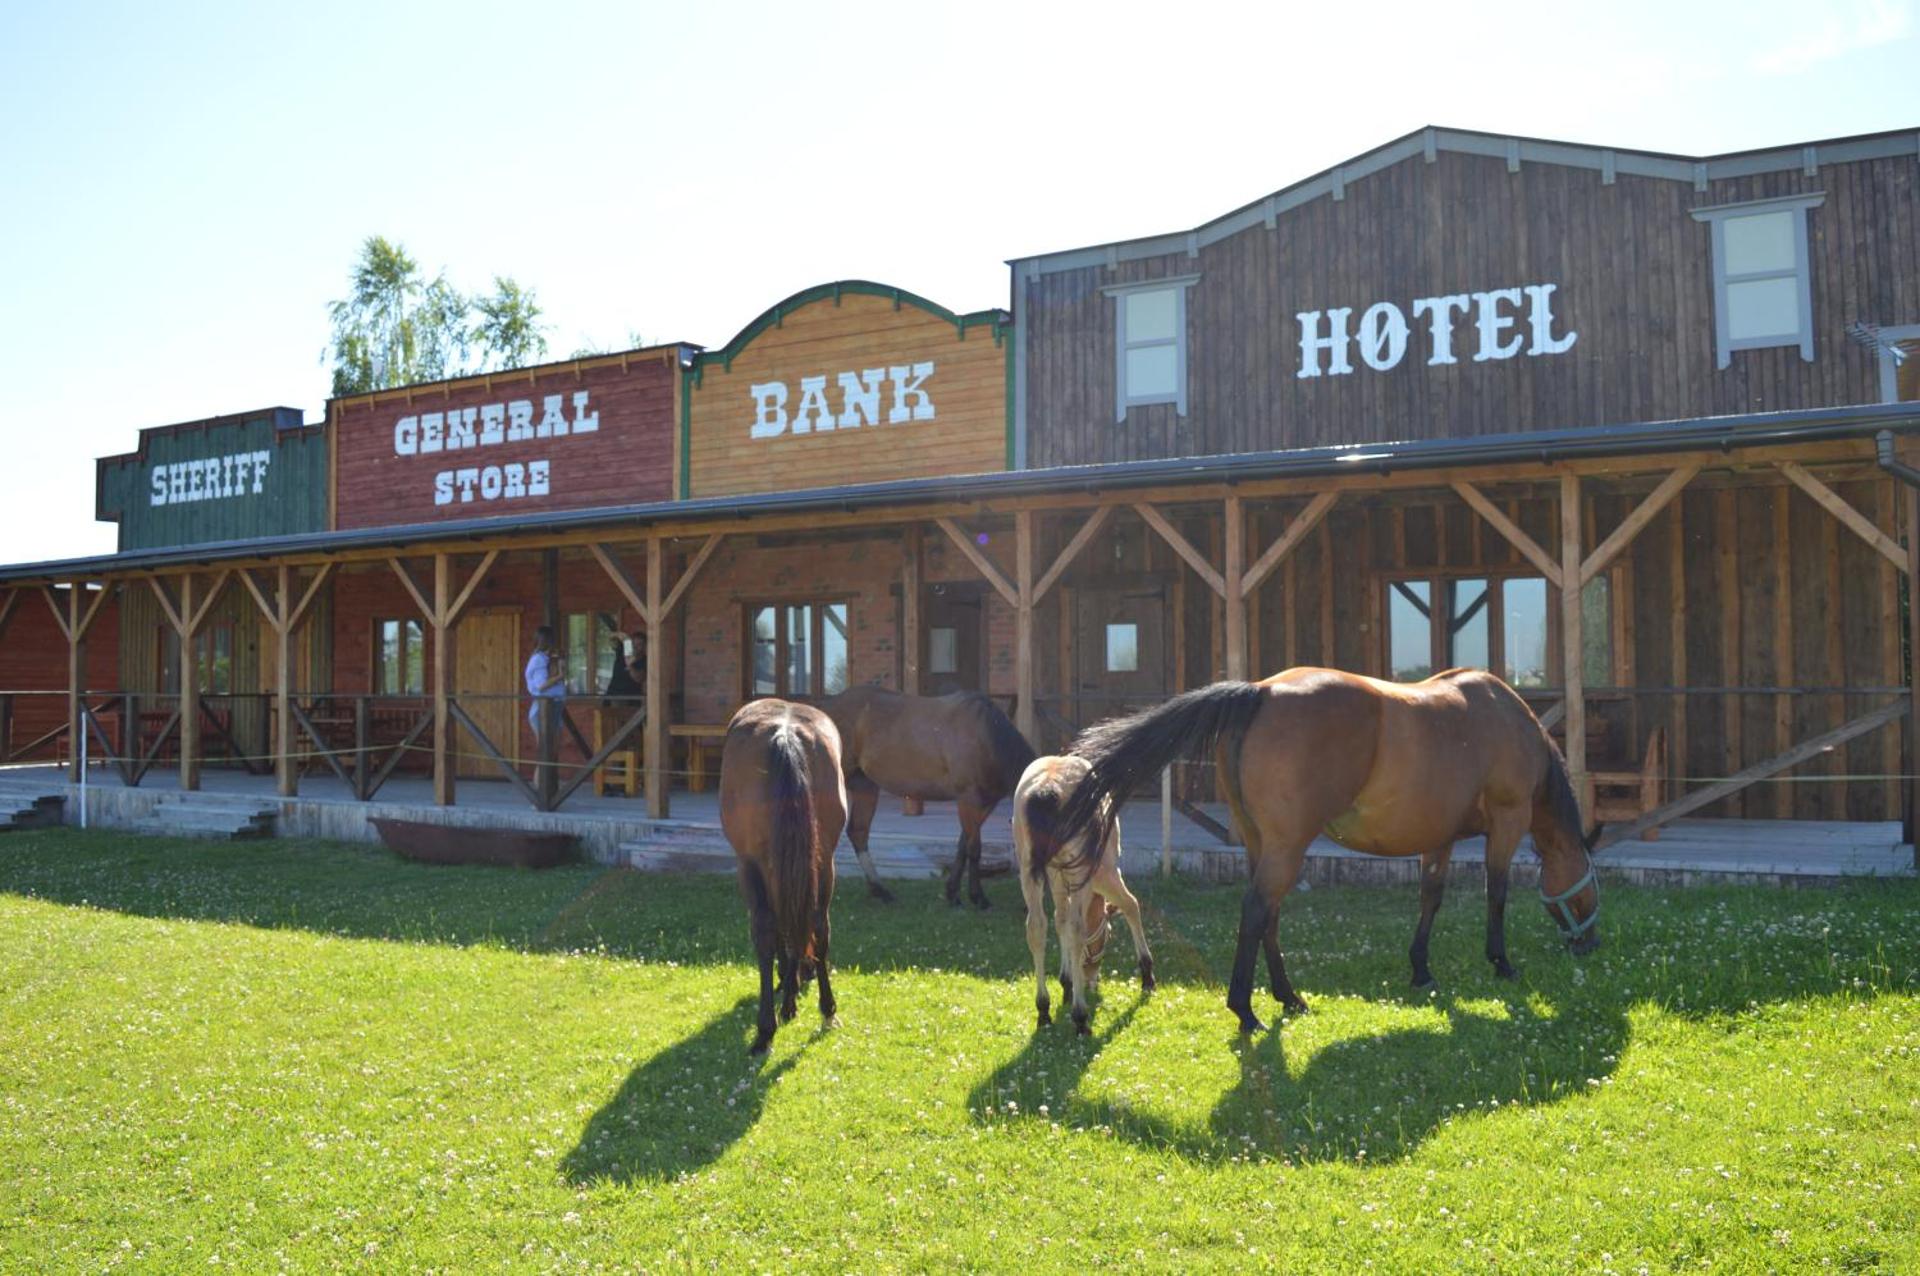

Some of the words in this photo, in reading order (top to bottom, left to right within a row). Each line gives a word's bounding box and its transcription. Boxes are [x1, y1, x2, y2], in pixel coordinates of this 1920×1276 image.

[395, 391, 598, 455] GENERAL
[751, 362, 935, 438] BANK
[151, 450, 270, 505] SHERIFF
[435, 460, 549, 505] STORE
